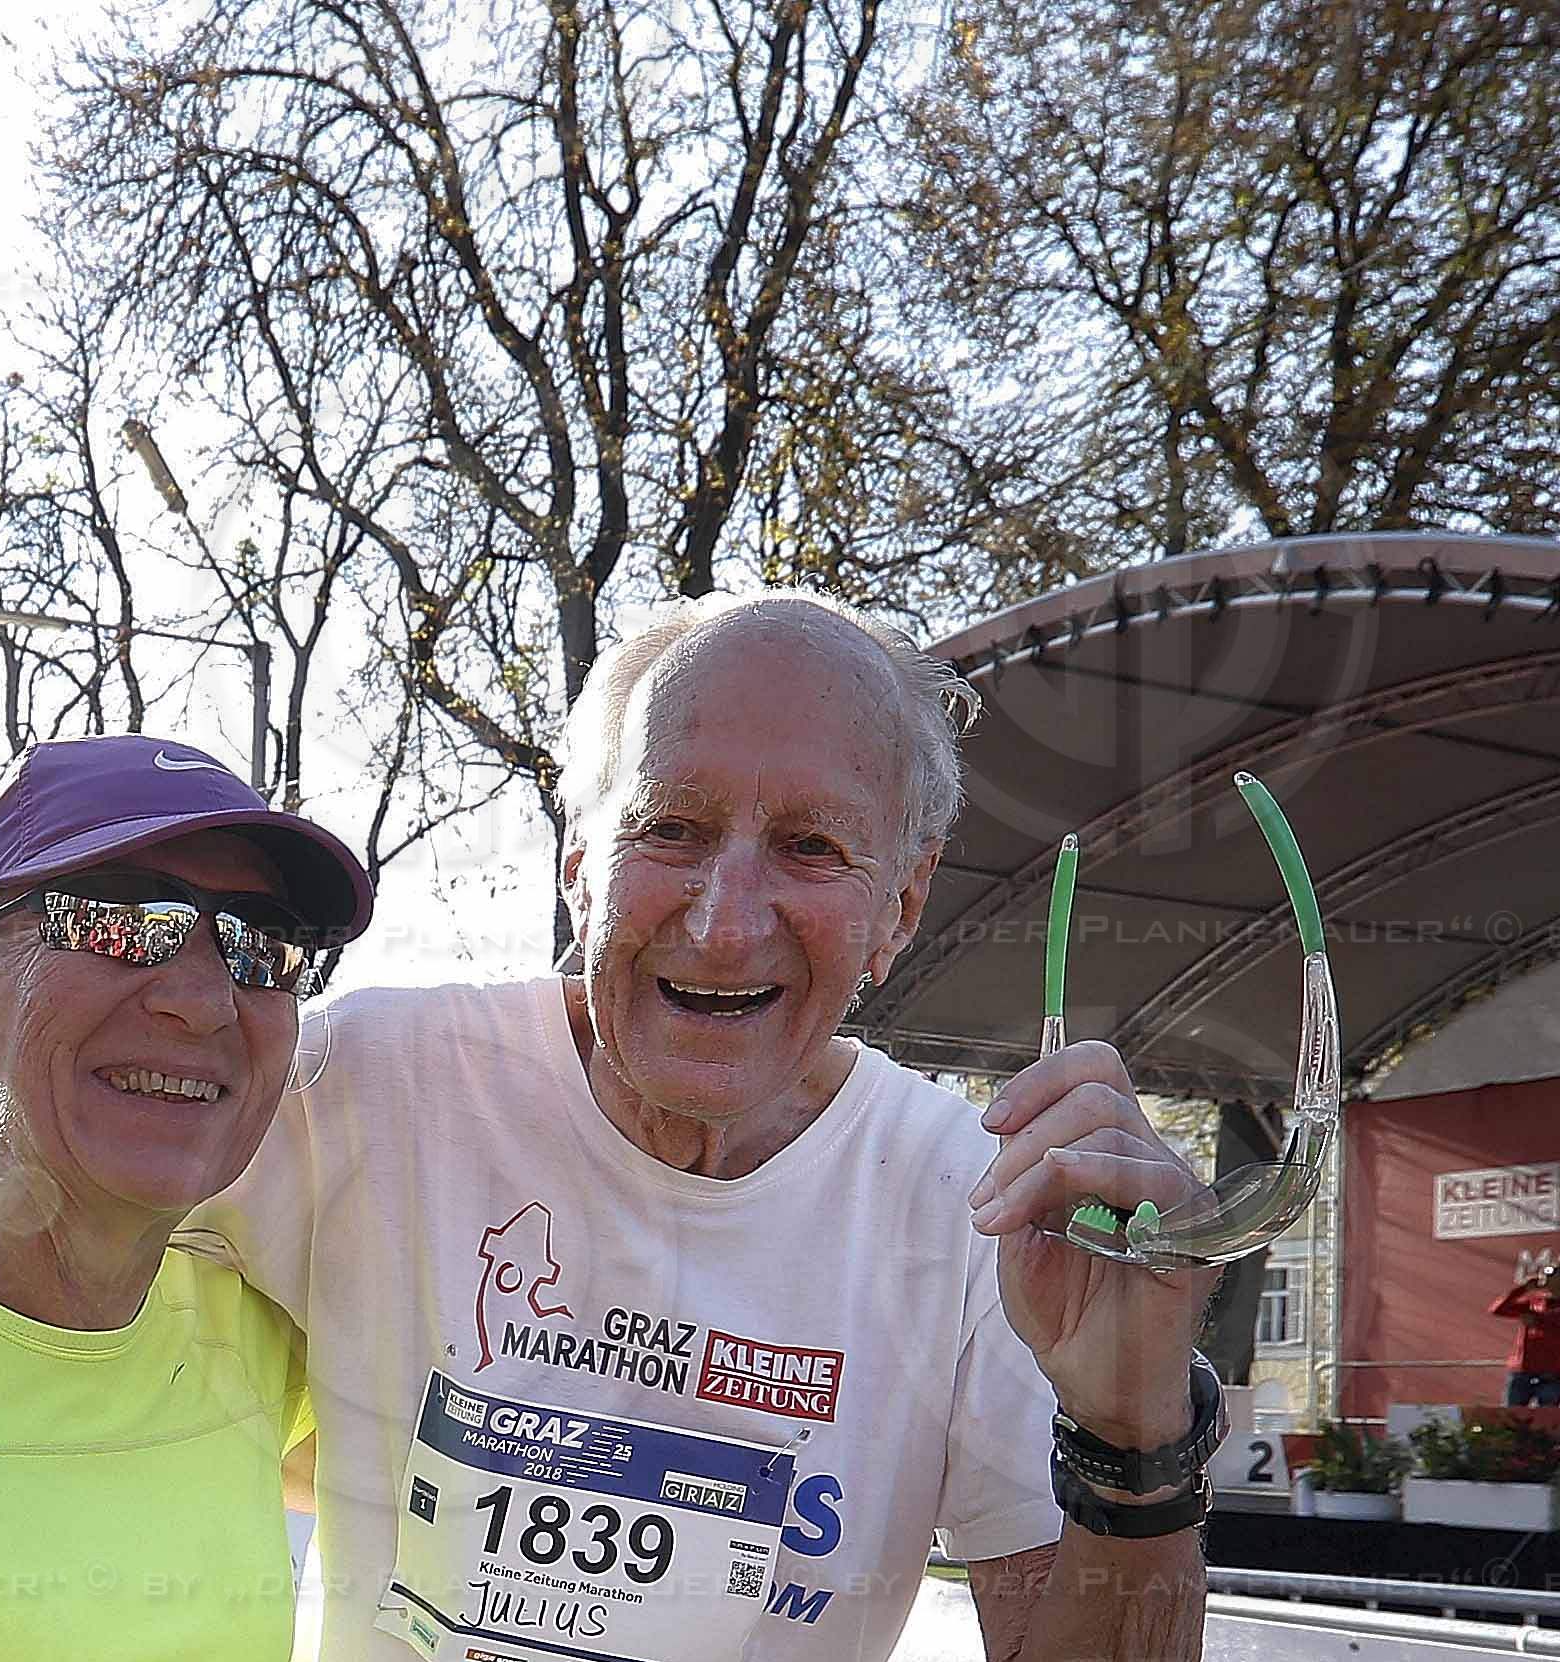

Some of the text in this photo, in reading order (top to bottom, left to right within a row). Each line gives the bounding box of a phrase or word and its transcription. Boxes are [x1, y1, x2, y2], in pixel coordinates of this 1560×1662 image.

[1442, 1166, 1554, 1201] KLEINE
[604, 1307, 697, 1355] GRAZ
[501, 1321, 689, 1395] MARATHON
[711, 1339, 836, 1386] KLEINE
[447, 1403, 482, 1424] ZEITUNG
[449, 1392, 484, 1413] KLEINE
[704, 1373, 830, 1414] ZEITUNG
[462, 1430, 554, 1462] MARATHON
[489, 1407, 590, 1449] GRAZ
[613, 1443, 633, 1457] 25
[1247, 1441, 1274, 1482] 2
[524, 1462, 563, 1480] 2018
[420, 1497, 427, 1510] 1
[664, 1482, 740, 1511] GRAZ
[473, 1484, 675, 1585] 1839
[478, 1561, 522, 1581] Kleine
[523, 1570, 576, 1594] Zeitung
[579, 1581, 643, 1604] Marathon
[459, 1579, 608, 1638] JULIUS
